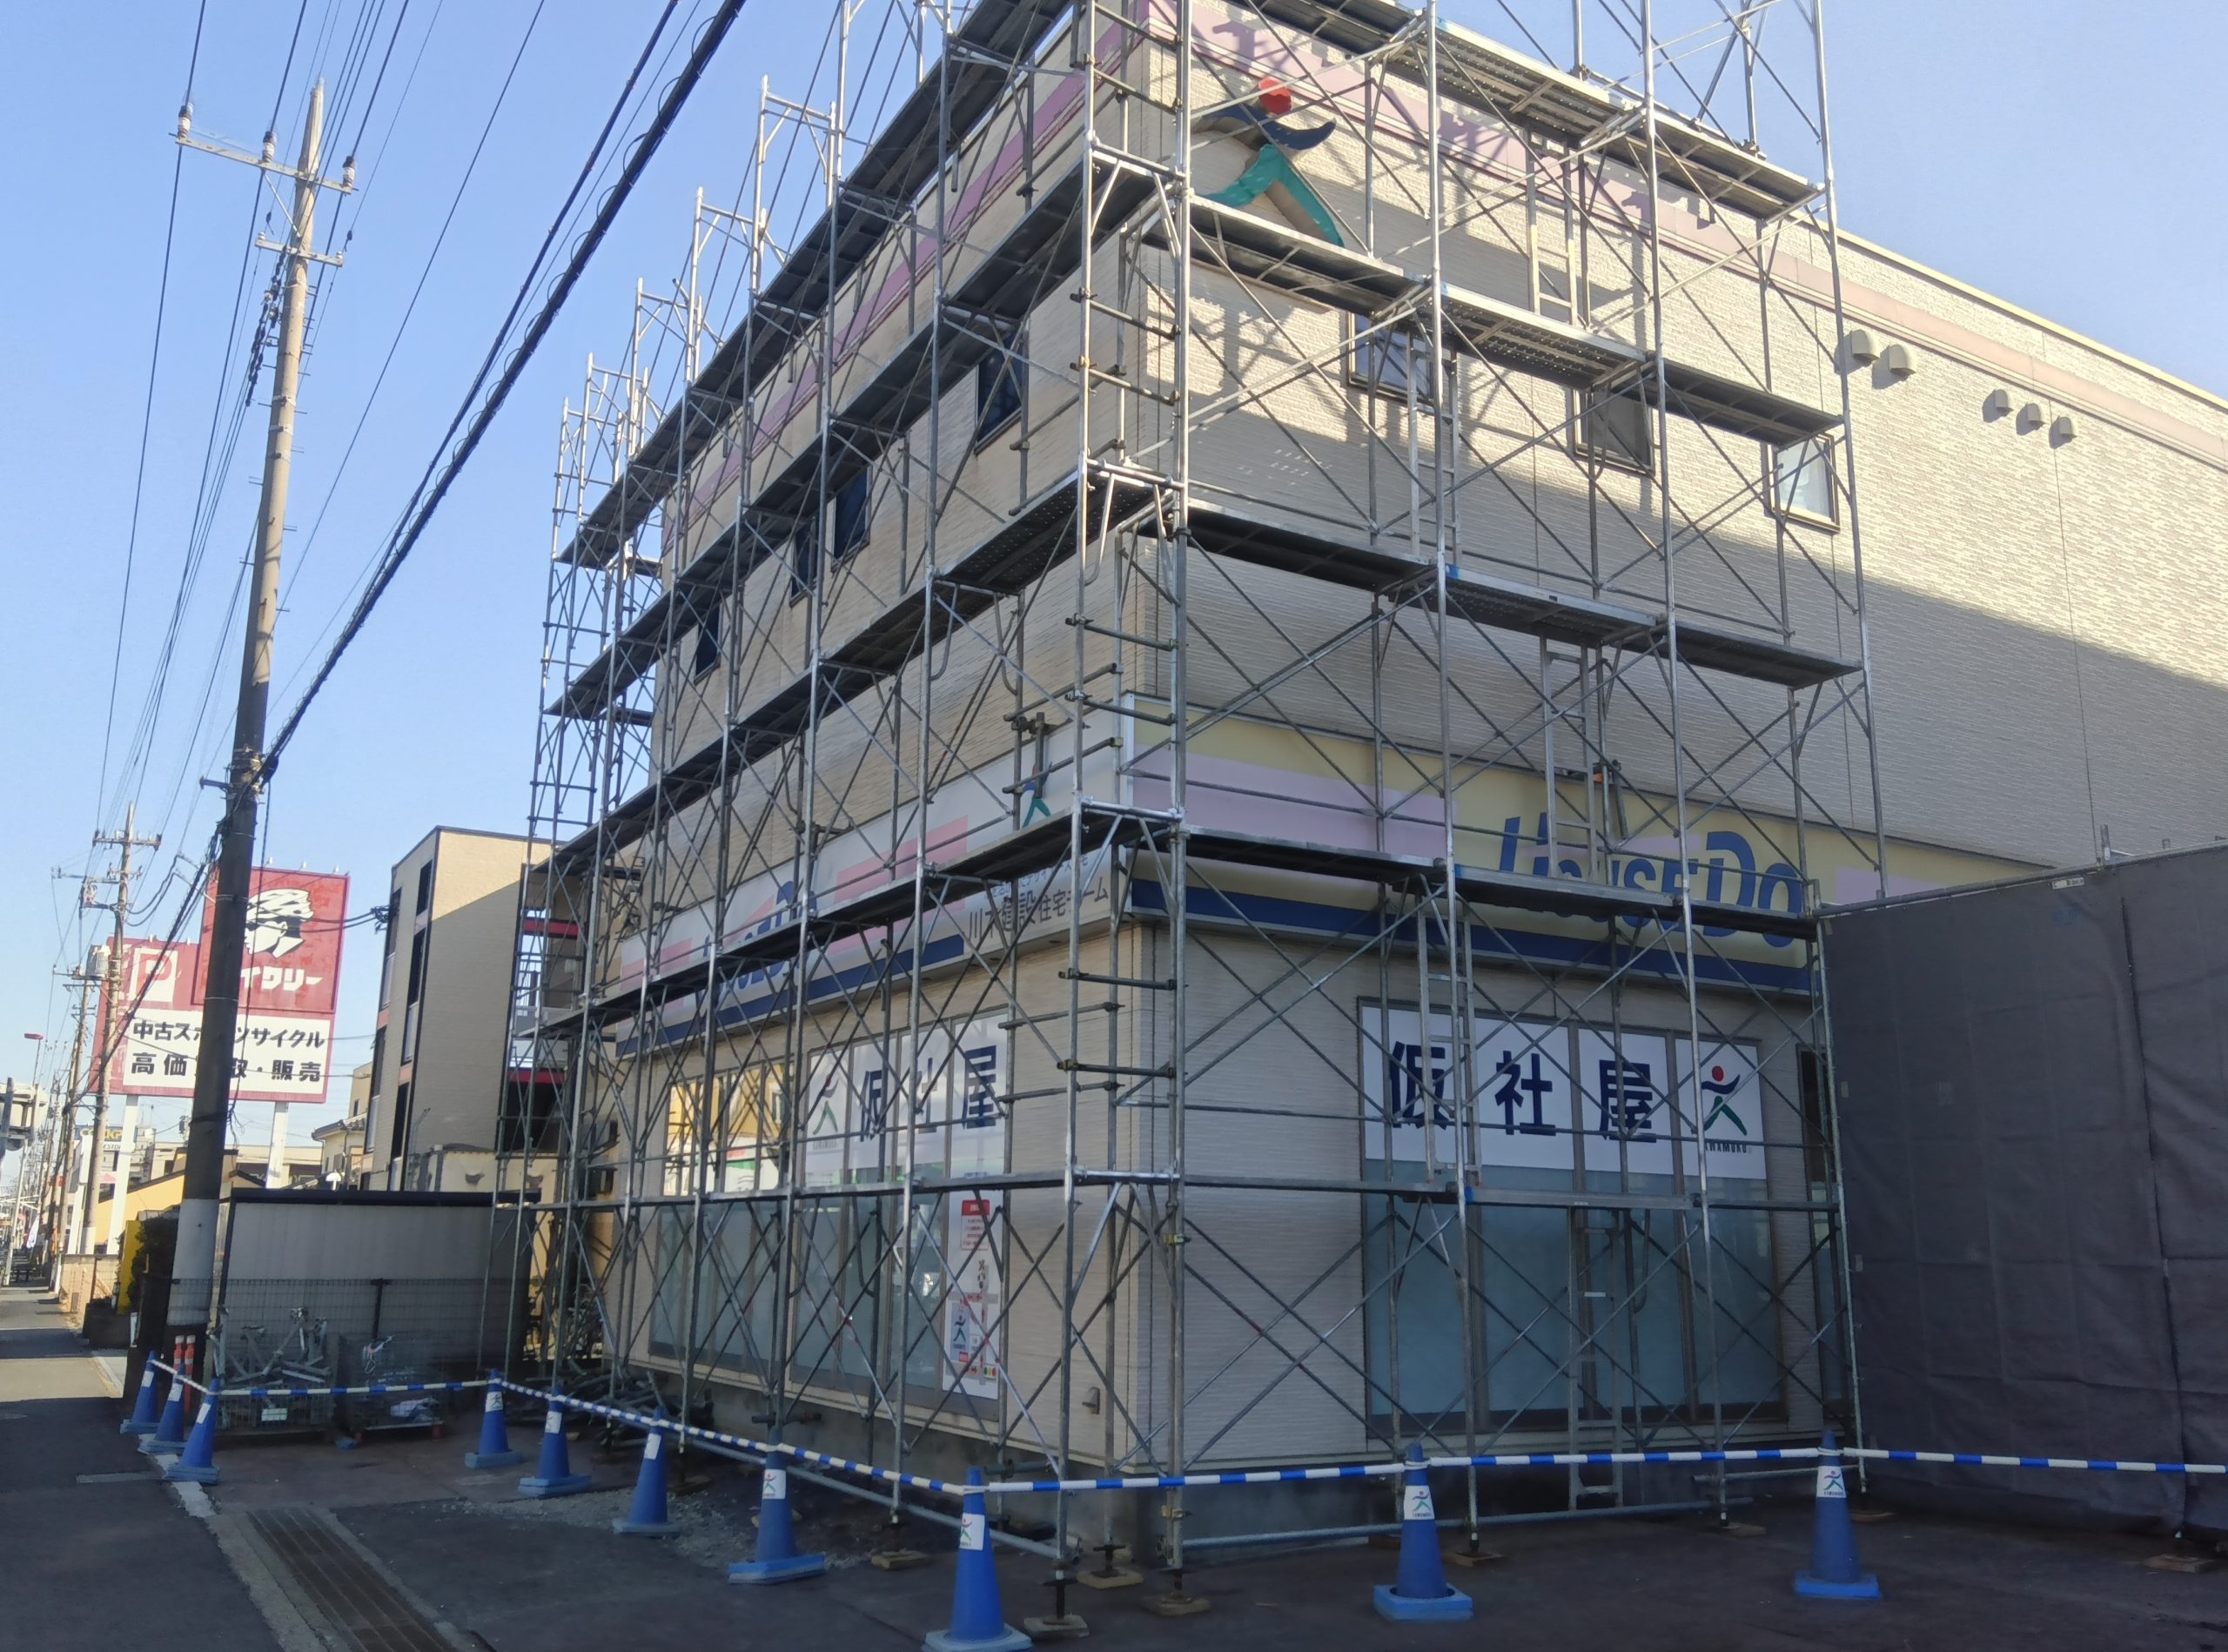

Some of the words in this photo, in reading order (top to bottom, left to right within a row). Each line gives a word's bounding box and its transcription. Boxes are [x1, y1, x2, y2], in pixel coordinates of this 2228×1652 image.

[135, 953, 173, 997] P
[133, 1020, 325, 1049] 中古スツサイクル
[131, 1051, 321, 1082] 高価取・販売
[1392, 1041, 1656, 1144] 仮社屋
